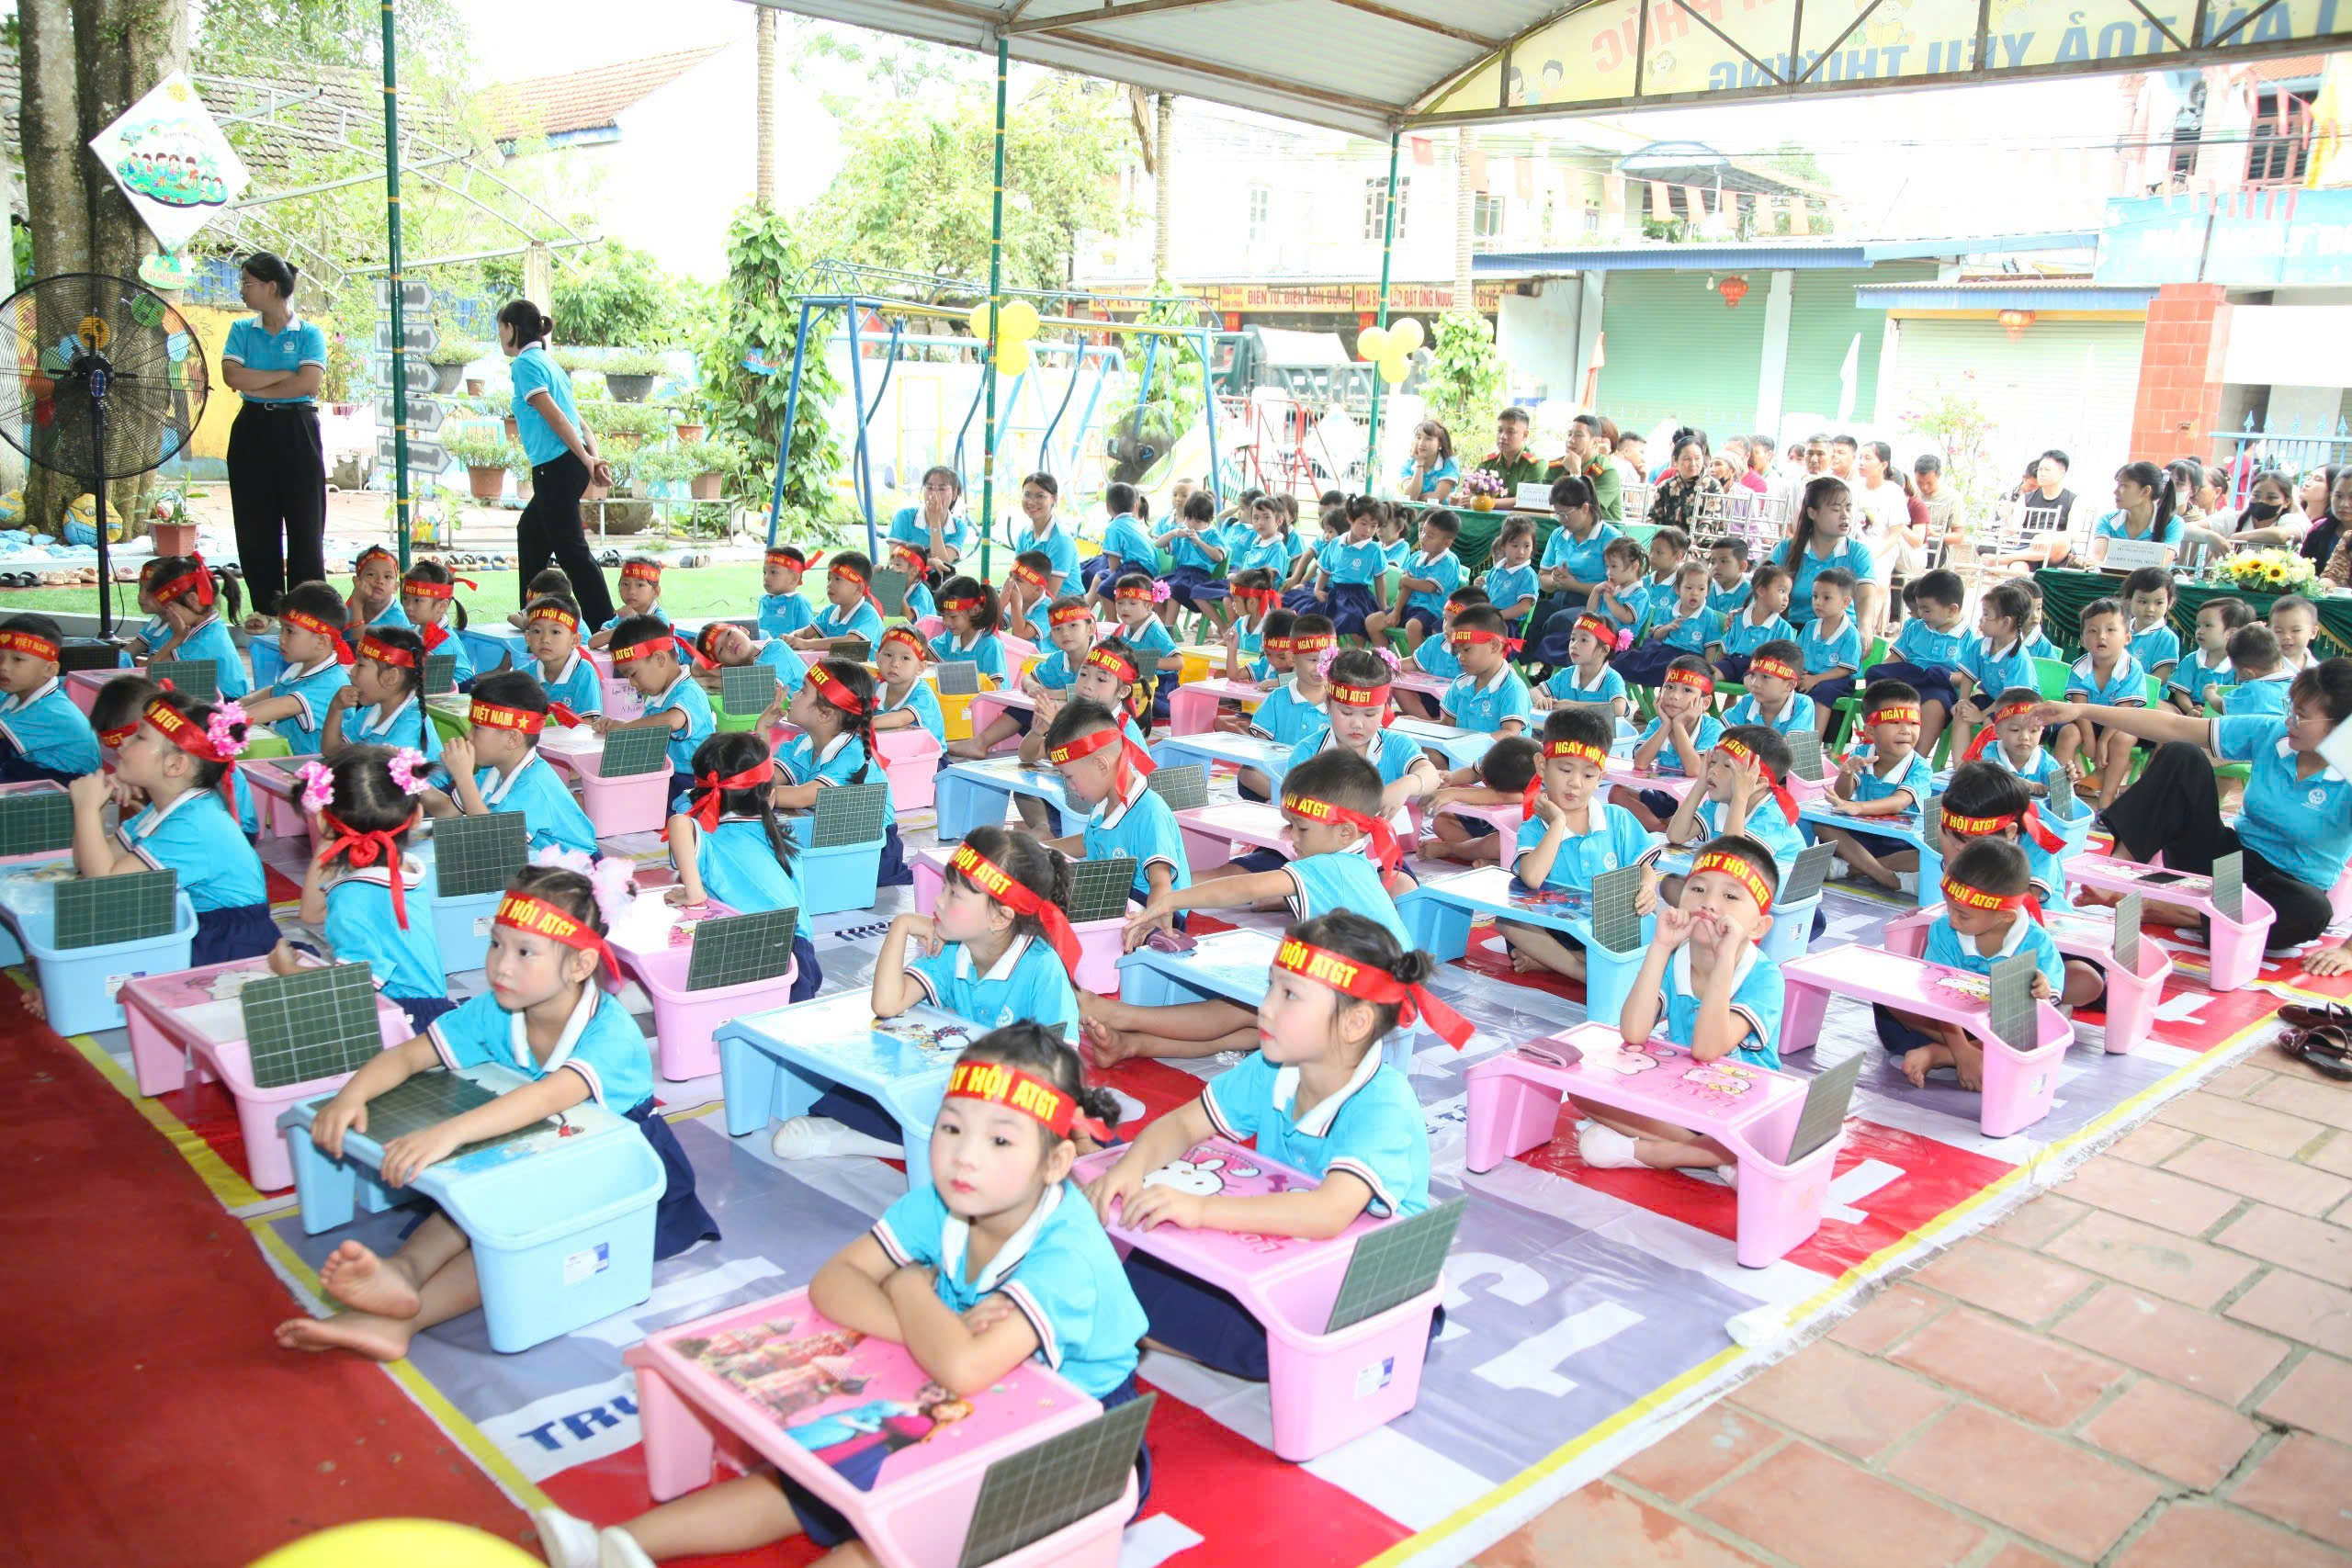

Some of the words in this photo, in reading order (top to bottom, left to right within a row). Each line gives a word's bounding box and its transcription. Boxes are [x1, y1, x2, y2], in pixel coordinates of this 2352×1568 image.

[542, 607, 557, 618] HỘI
[559, 612, 575, 626] ATGT
[15, 636, 32, 649] VIỆT
[33, 641, 49, 652] NAM
[1455, 631, 1471, 640] ATGT
[363, 645, 380, 658] NAM
[616, 646, 635, 660] ATGT
[1101, 654, 1122, 671] ATGT
[809, 665, 829, 684] ATGT
[1349, 689, 1371, 703] ATGT
[152, 707, 184, 732] ATGT
[472, 705, 490, 723] VIỆT
[491, 709, 514, 726] NAM
[1725, 739, 1750, 758] ATGT
[1298, 797, 1330, 818] ATGT
[1950, 815, 1969, 832] HỘI
[1970, 818, 1998, 831] ATGT
[955, 846, 976, 871] HỘI
[972, 862, 1012, 896] ATGT
[1723, 856, 1750, 879] HỘI
[1747, 874, 1770, 908] ATGT
[1947, 880, 1971, 901] HỘI
[1970, 893, 2002, 910] ATGT
[510, 899, 537, 928] HỘI
[537, 911, 578, 938] ATGT
[1278, 941, 1308, 971] HỘI
[1306, 953, 1358, 988] ATGT
[967, 1063, 1014, 1101] HỘI
[1012, 1079, 1060, 1122] ATGT
